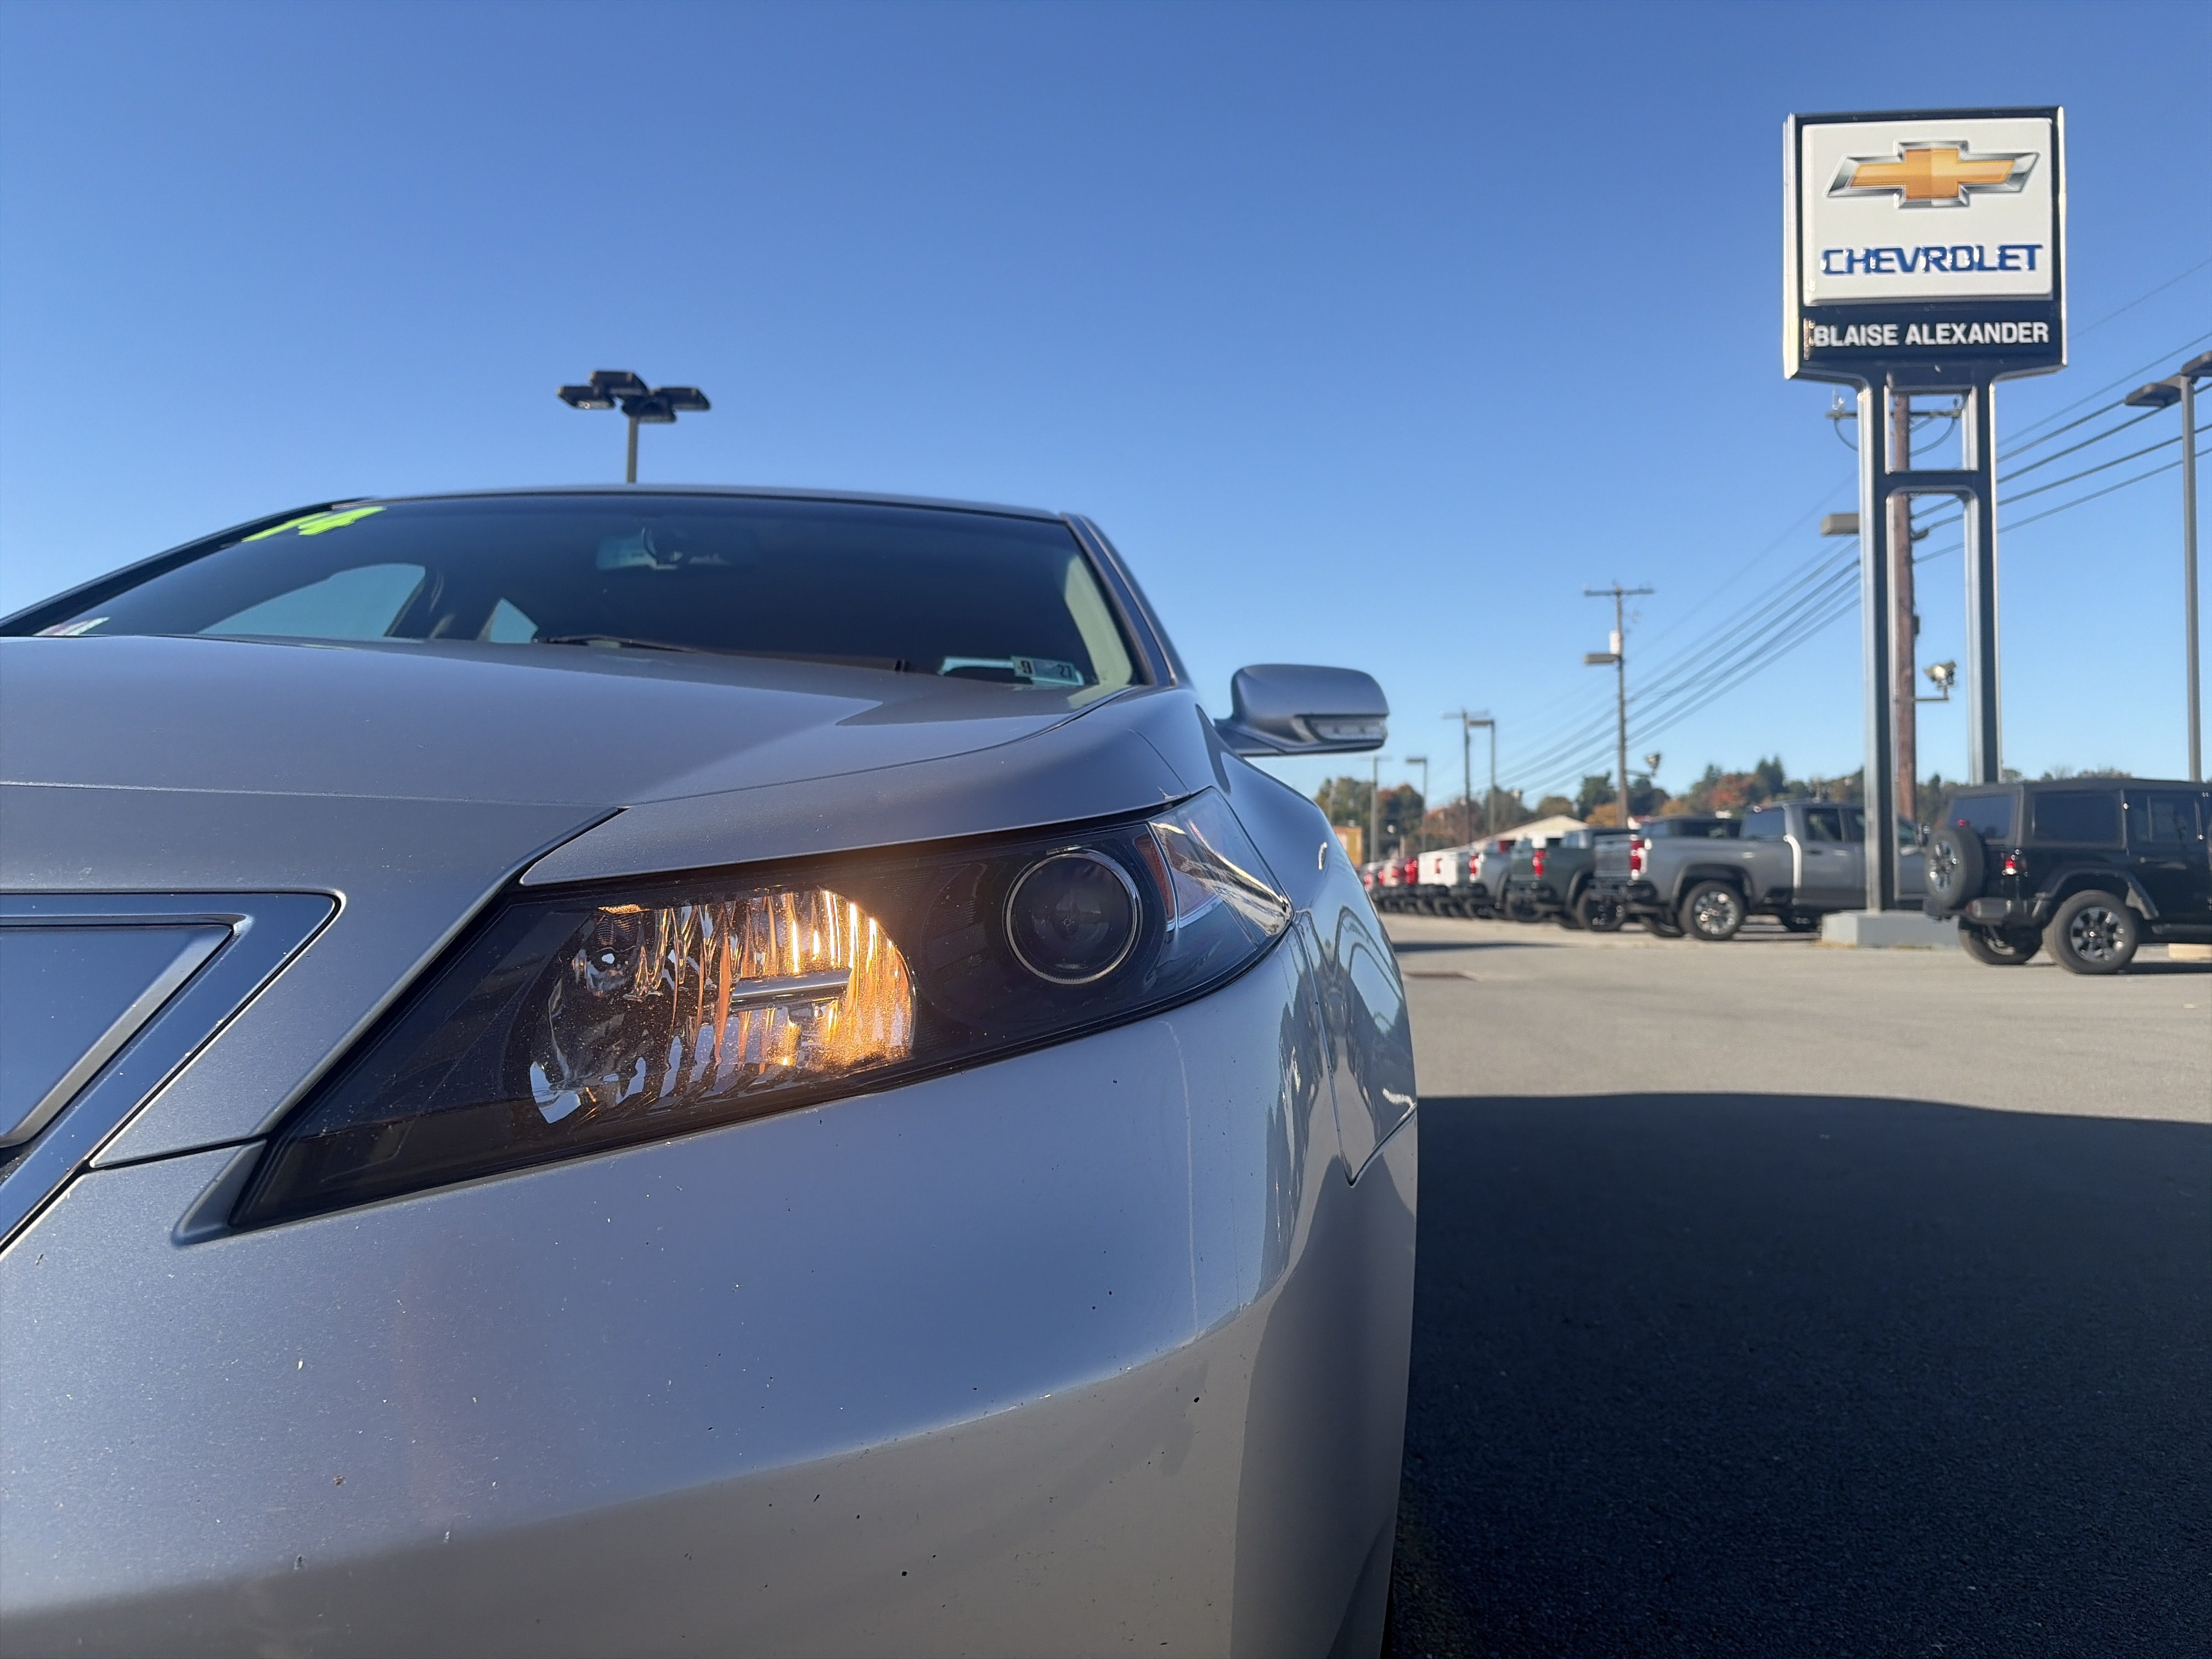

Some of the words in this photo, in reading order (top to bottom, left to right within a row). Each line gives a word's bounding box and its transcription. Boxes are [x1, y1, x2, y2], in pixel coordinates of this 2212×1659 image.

[1820, 244, 2043, 275] CHEVROLET
[1814, 324, 1899, 347] BLAISE
[1905, 321, 2050, 345] ALEXANDER
